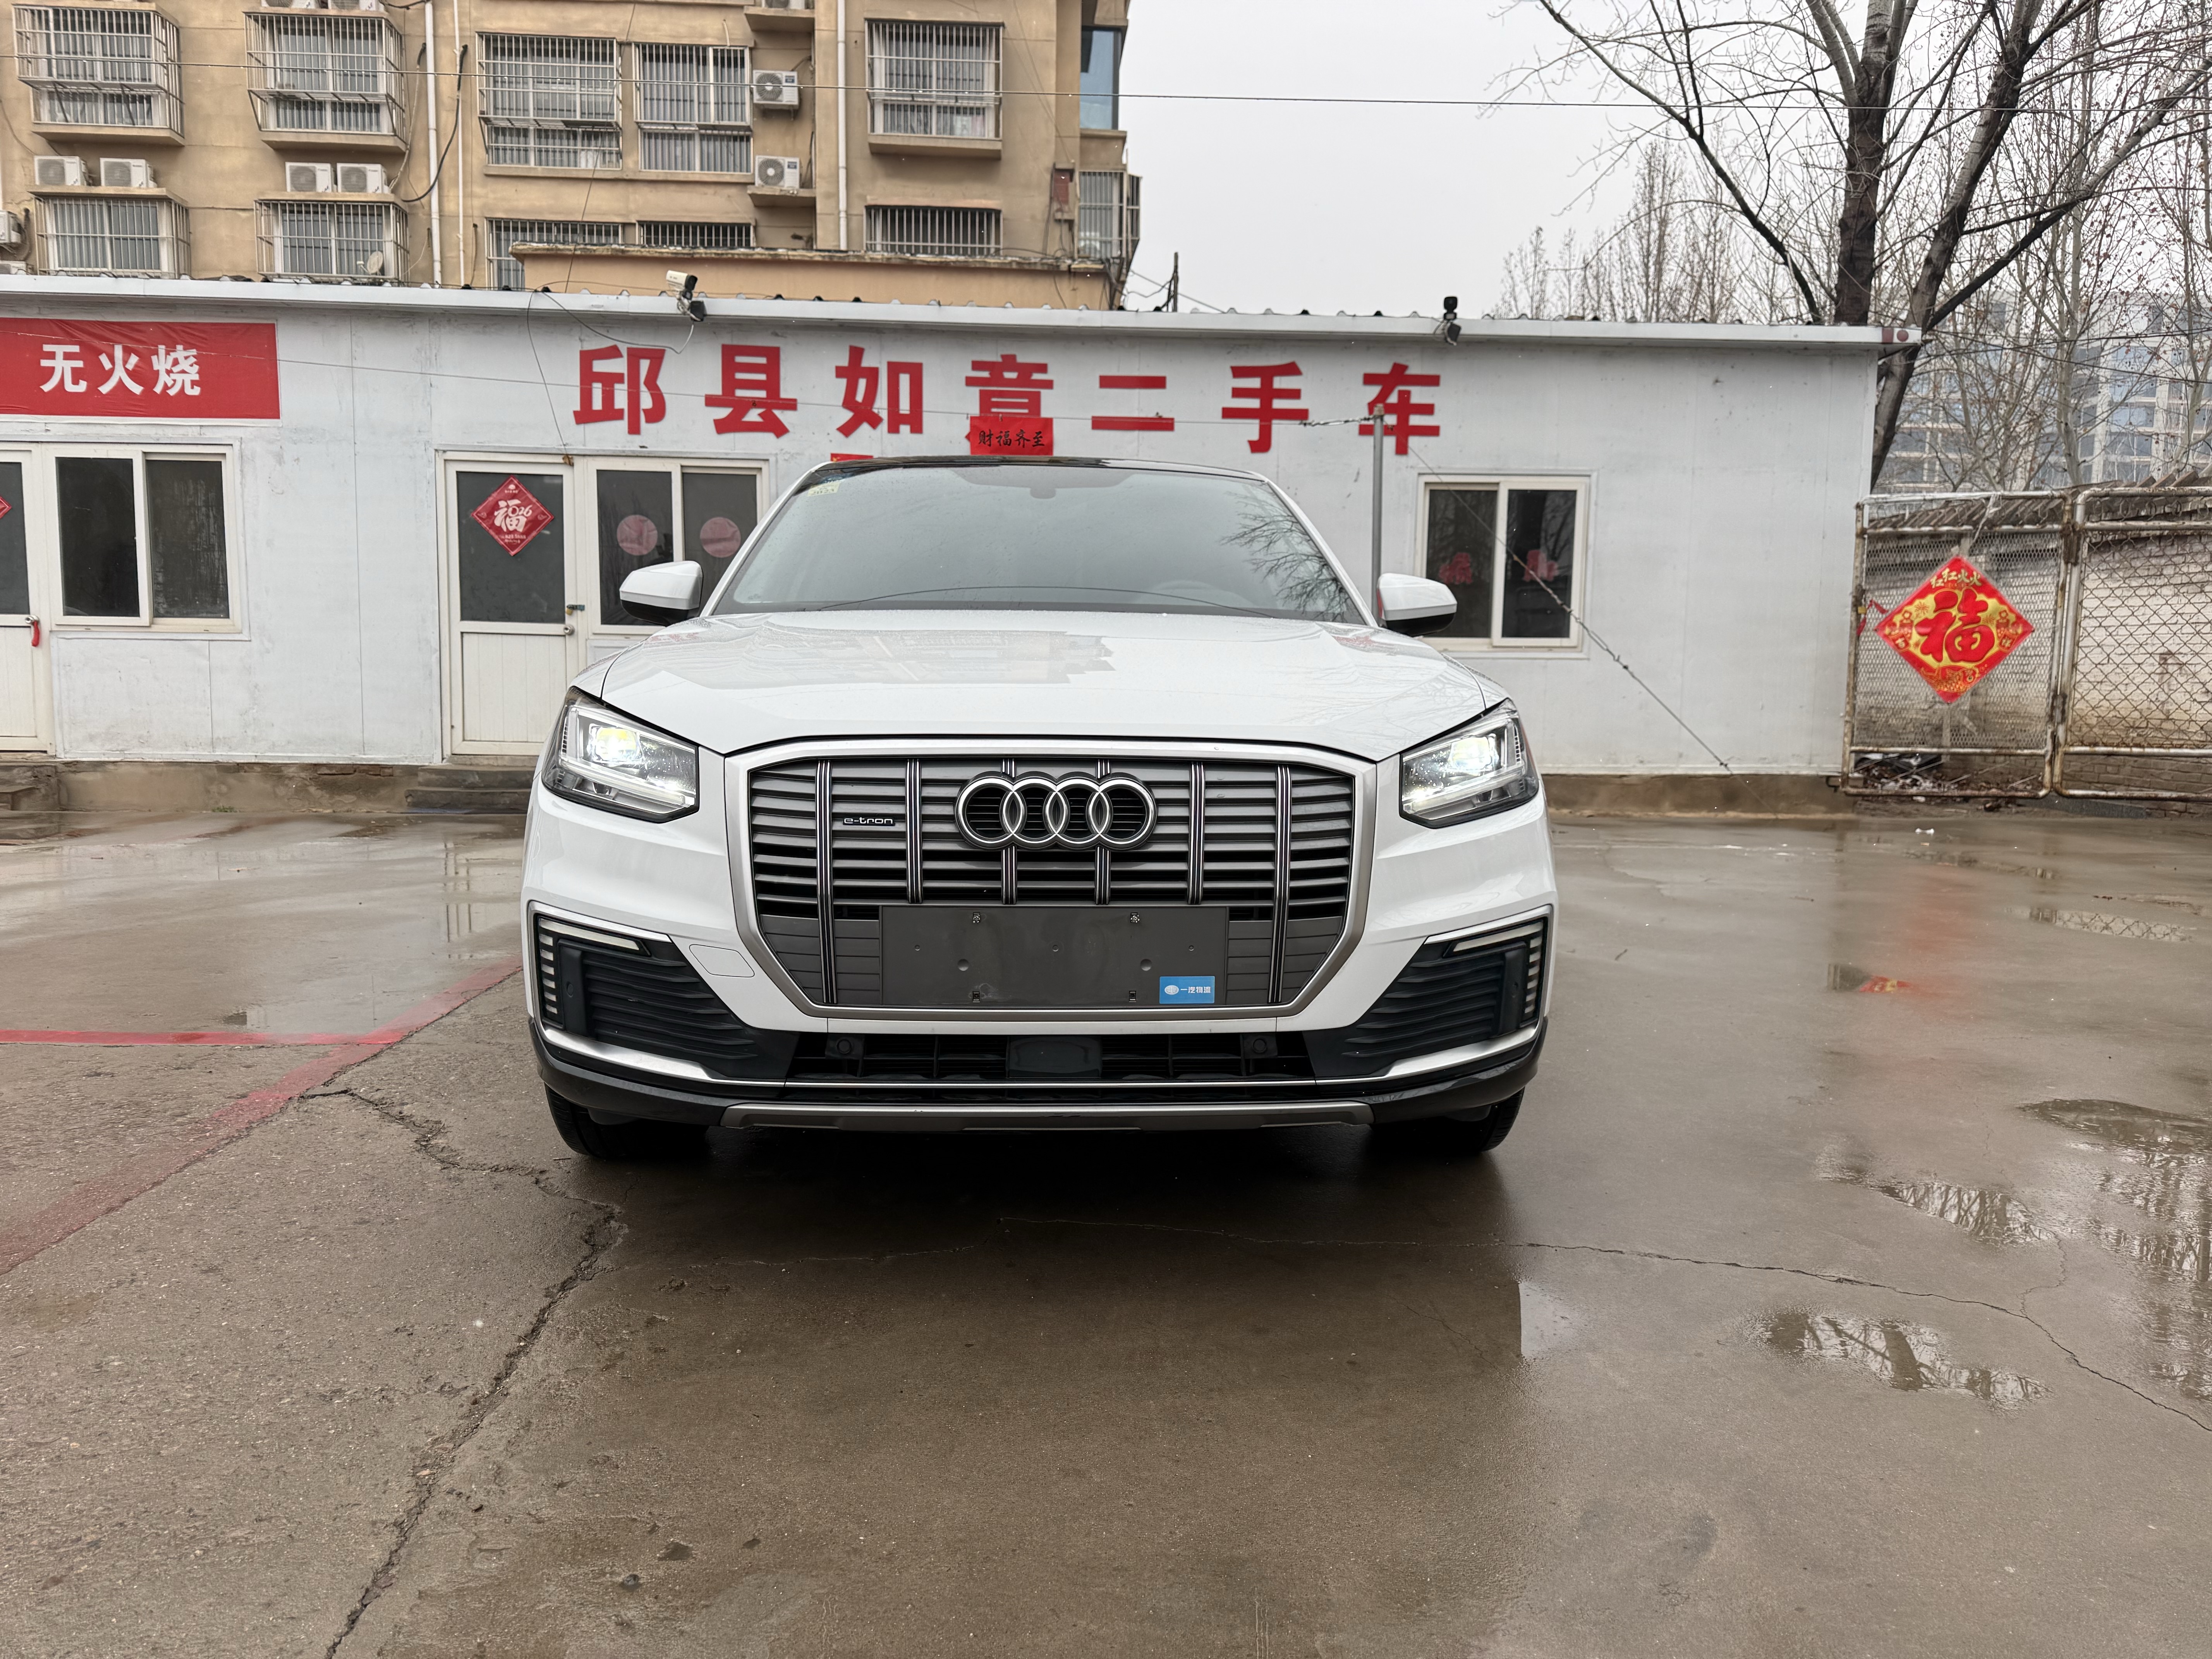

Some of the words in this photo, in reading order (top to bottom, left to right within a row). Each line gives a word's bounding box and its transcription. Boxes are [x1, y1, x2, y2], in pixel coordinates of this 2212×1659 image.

[40, 344, 201, 396] 无火烧
[574, 345, 1439, 454] 邱县如意二手车
[979, 429, 1044, 448] 财福齐至
[494, 499, 527, 532] 福
[1930, 568, 1982, 588] 红红火火
[1915, 587, 1995, 663] 福
